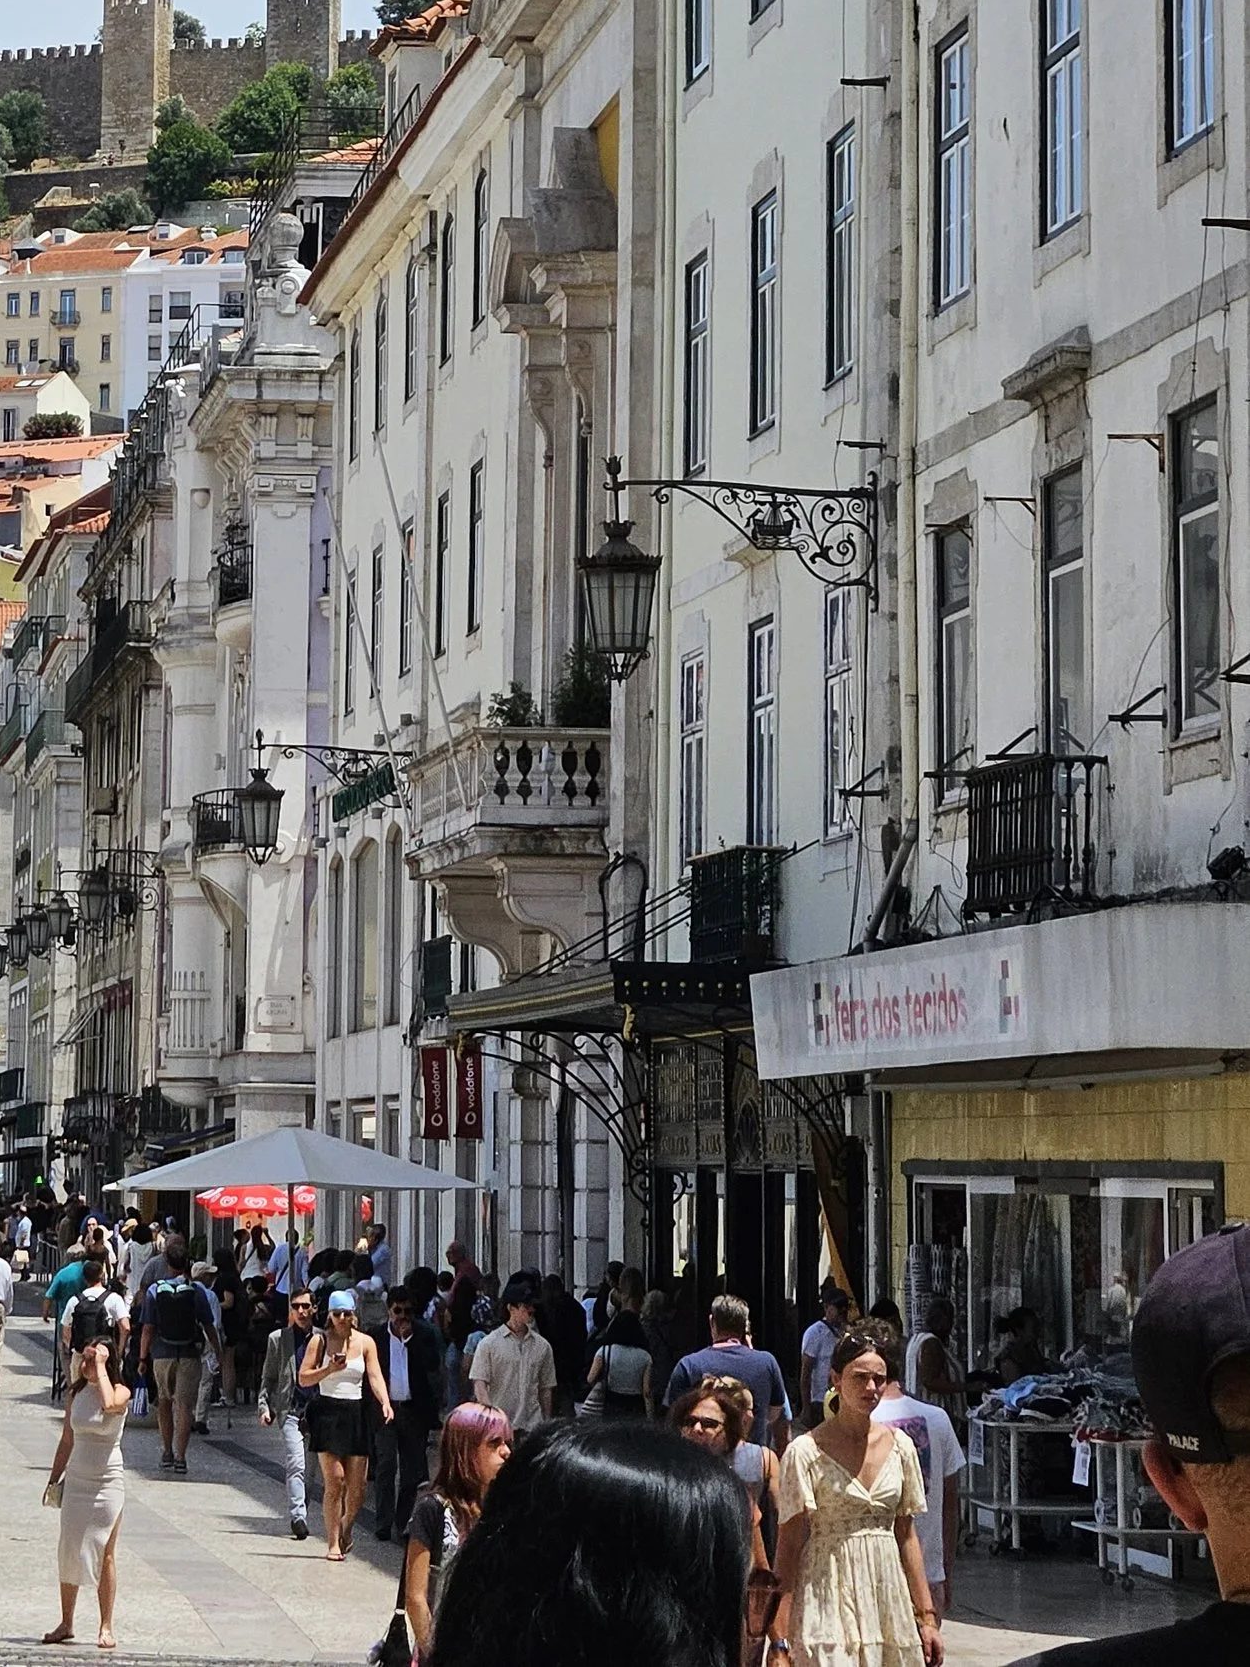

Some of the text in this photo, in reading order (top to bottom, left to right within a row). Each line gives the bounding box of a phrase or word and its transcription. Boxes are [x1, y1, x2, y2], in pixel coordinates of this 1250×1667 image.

[872, 981, 901, 1039] dos
[904, 972, 969, 1036] tecidos
[432, 1060, 442, 1110] vodafone
[465, 1056, 476, 1108] vodafone
[1166, 1432, 1200, 1451] PALACE
